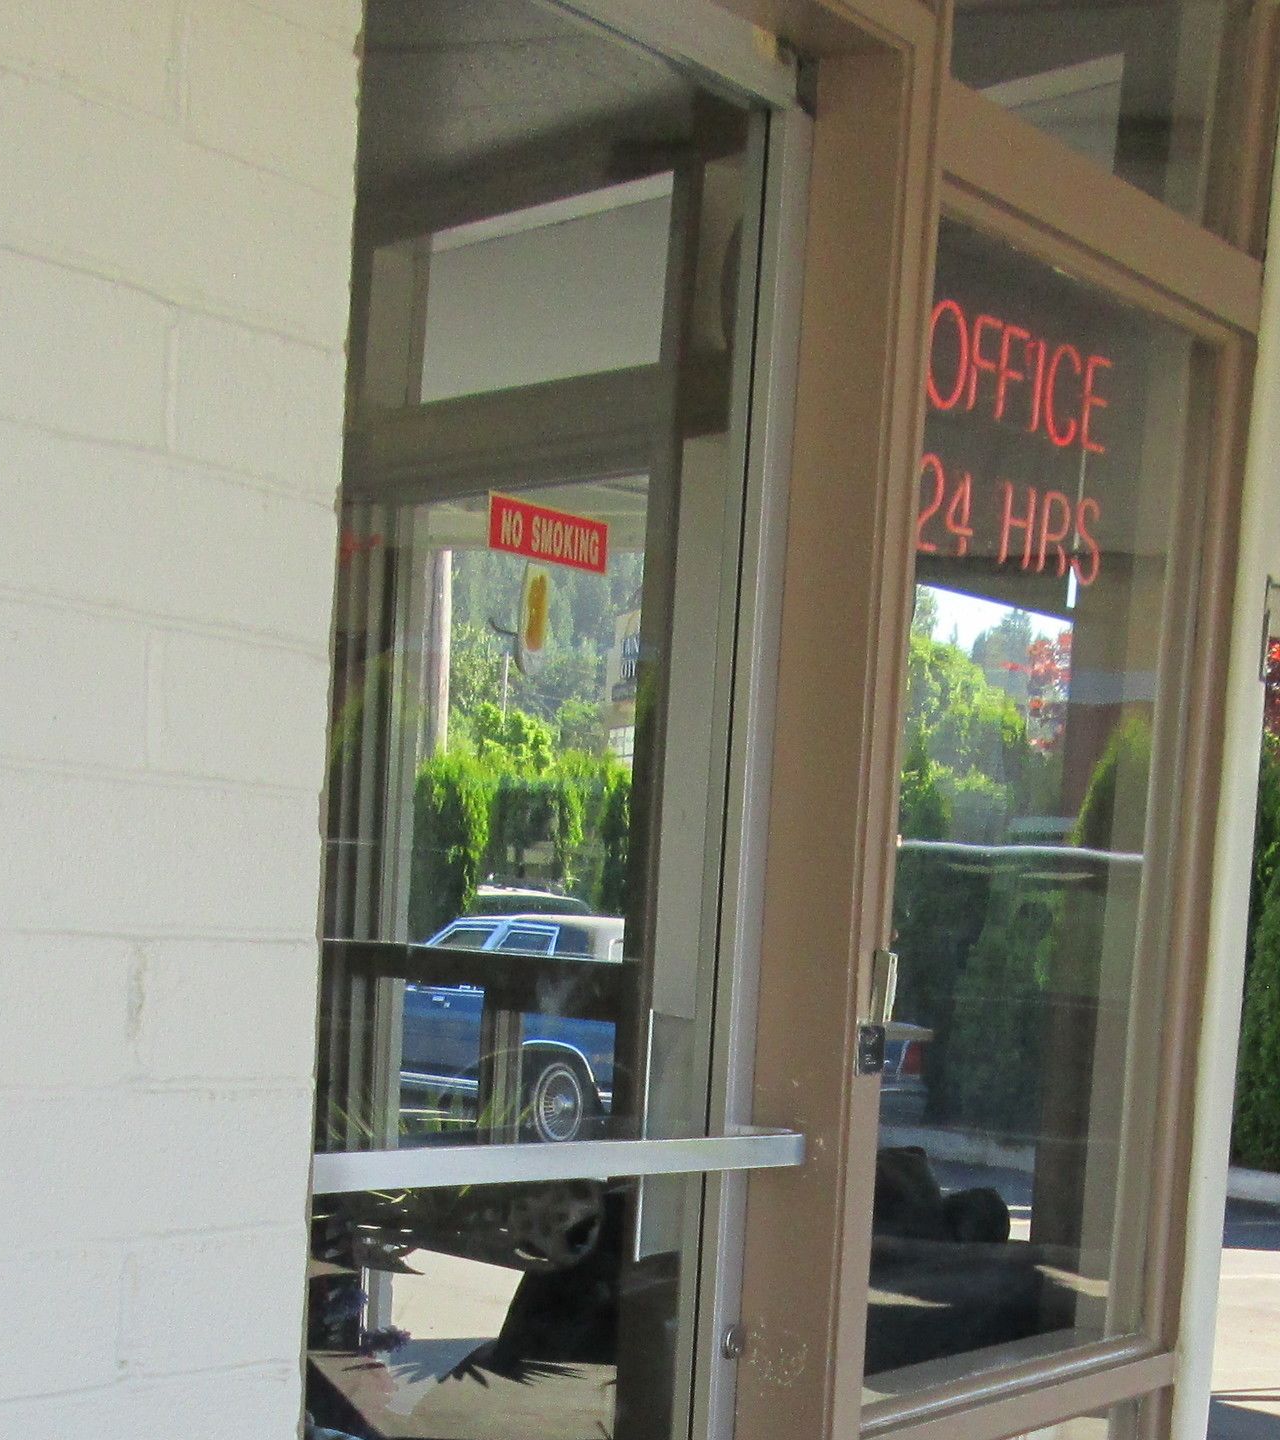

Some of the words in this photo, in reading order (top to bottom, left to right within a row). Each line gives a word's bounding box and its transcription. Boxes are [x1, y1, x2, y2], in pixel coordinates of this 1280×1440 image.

[926, 299, 1113, 454] OFFICE
[500, 507, 524, 548] NO
[531, 515, 600, 566] SMOKING
[915, 453, 974, 557] 24
[997, 480, 1101, 586] HRS
